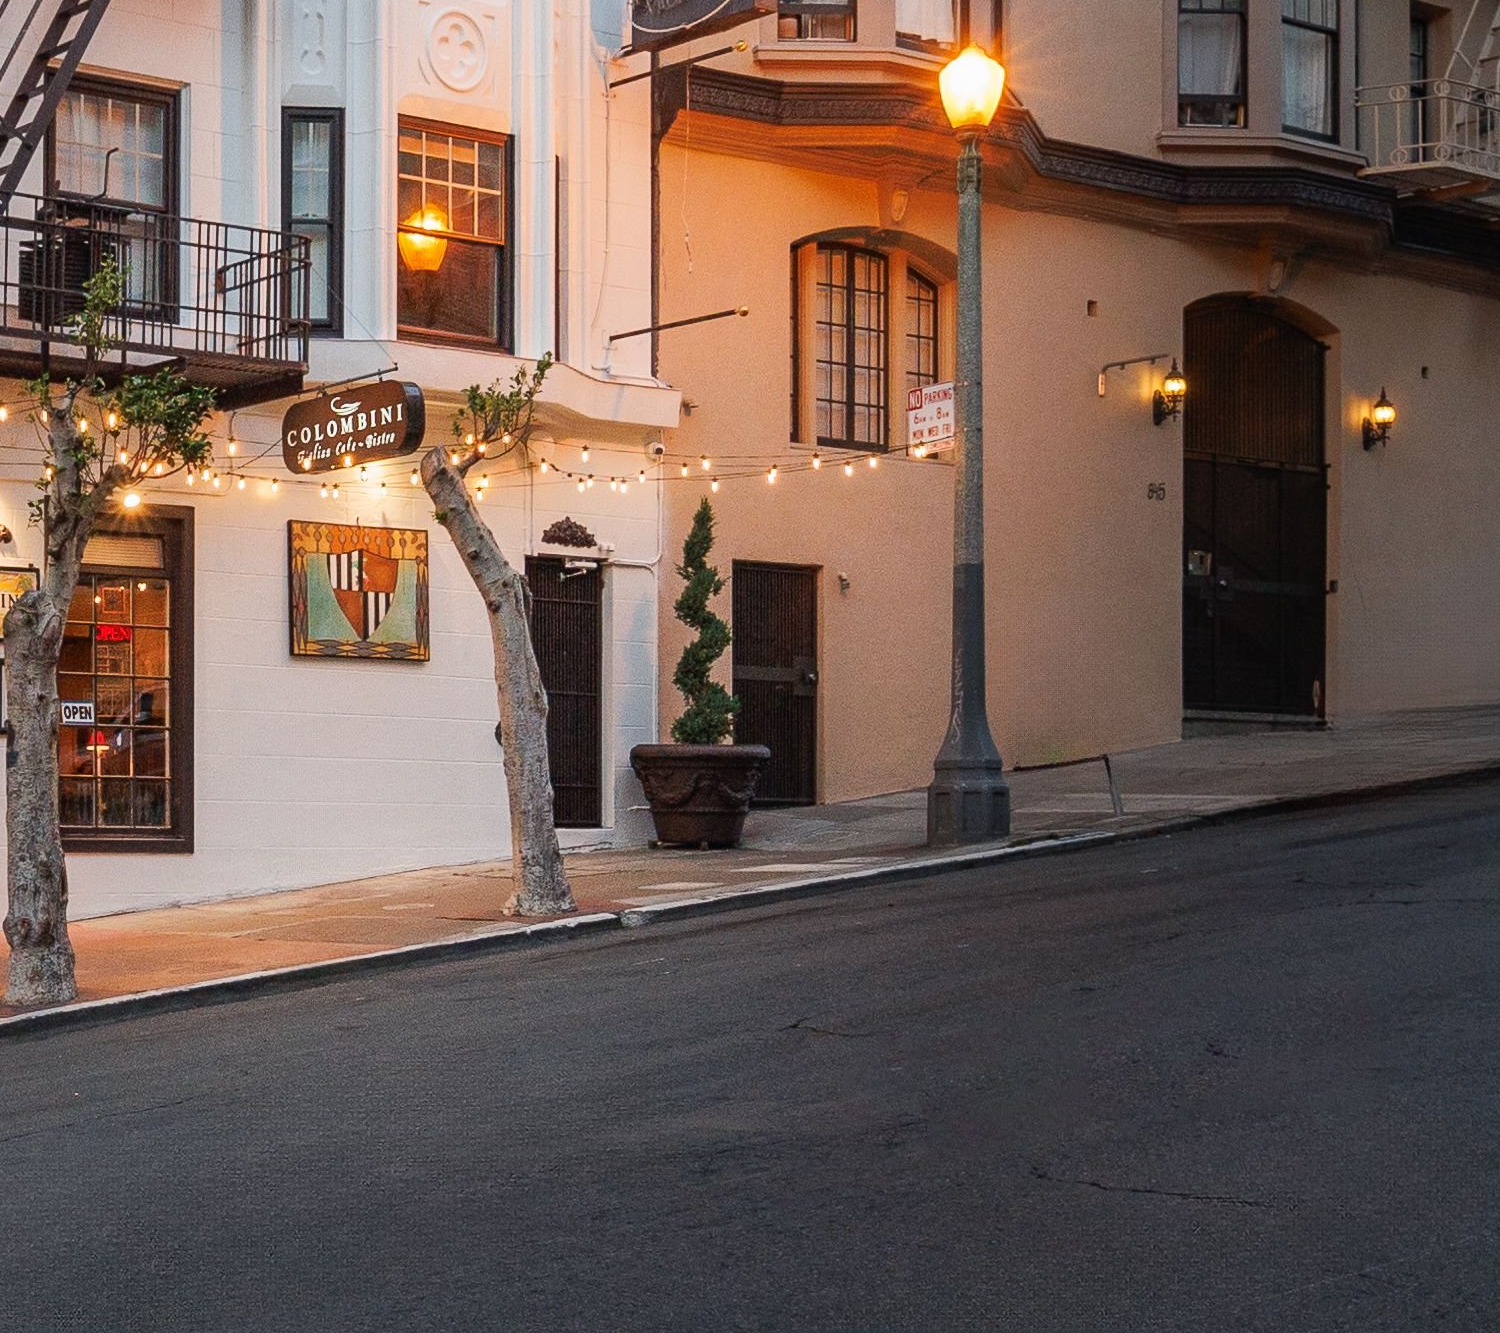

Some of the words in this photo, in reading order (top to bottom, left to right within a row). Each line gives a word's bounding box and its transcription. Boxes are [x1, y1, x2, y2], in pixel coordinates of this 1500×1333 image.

[909, 389, 922, 409] NO
[924, 386, 953, 405] PARKING
[287, 403, 403, 447] COLOMBINI
[1146, 482, 1166, 501] 845
[95, 624, 132, 641] OPEN
[63, 705, 93, 720] OPEN
